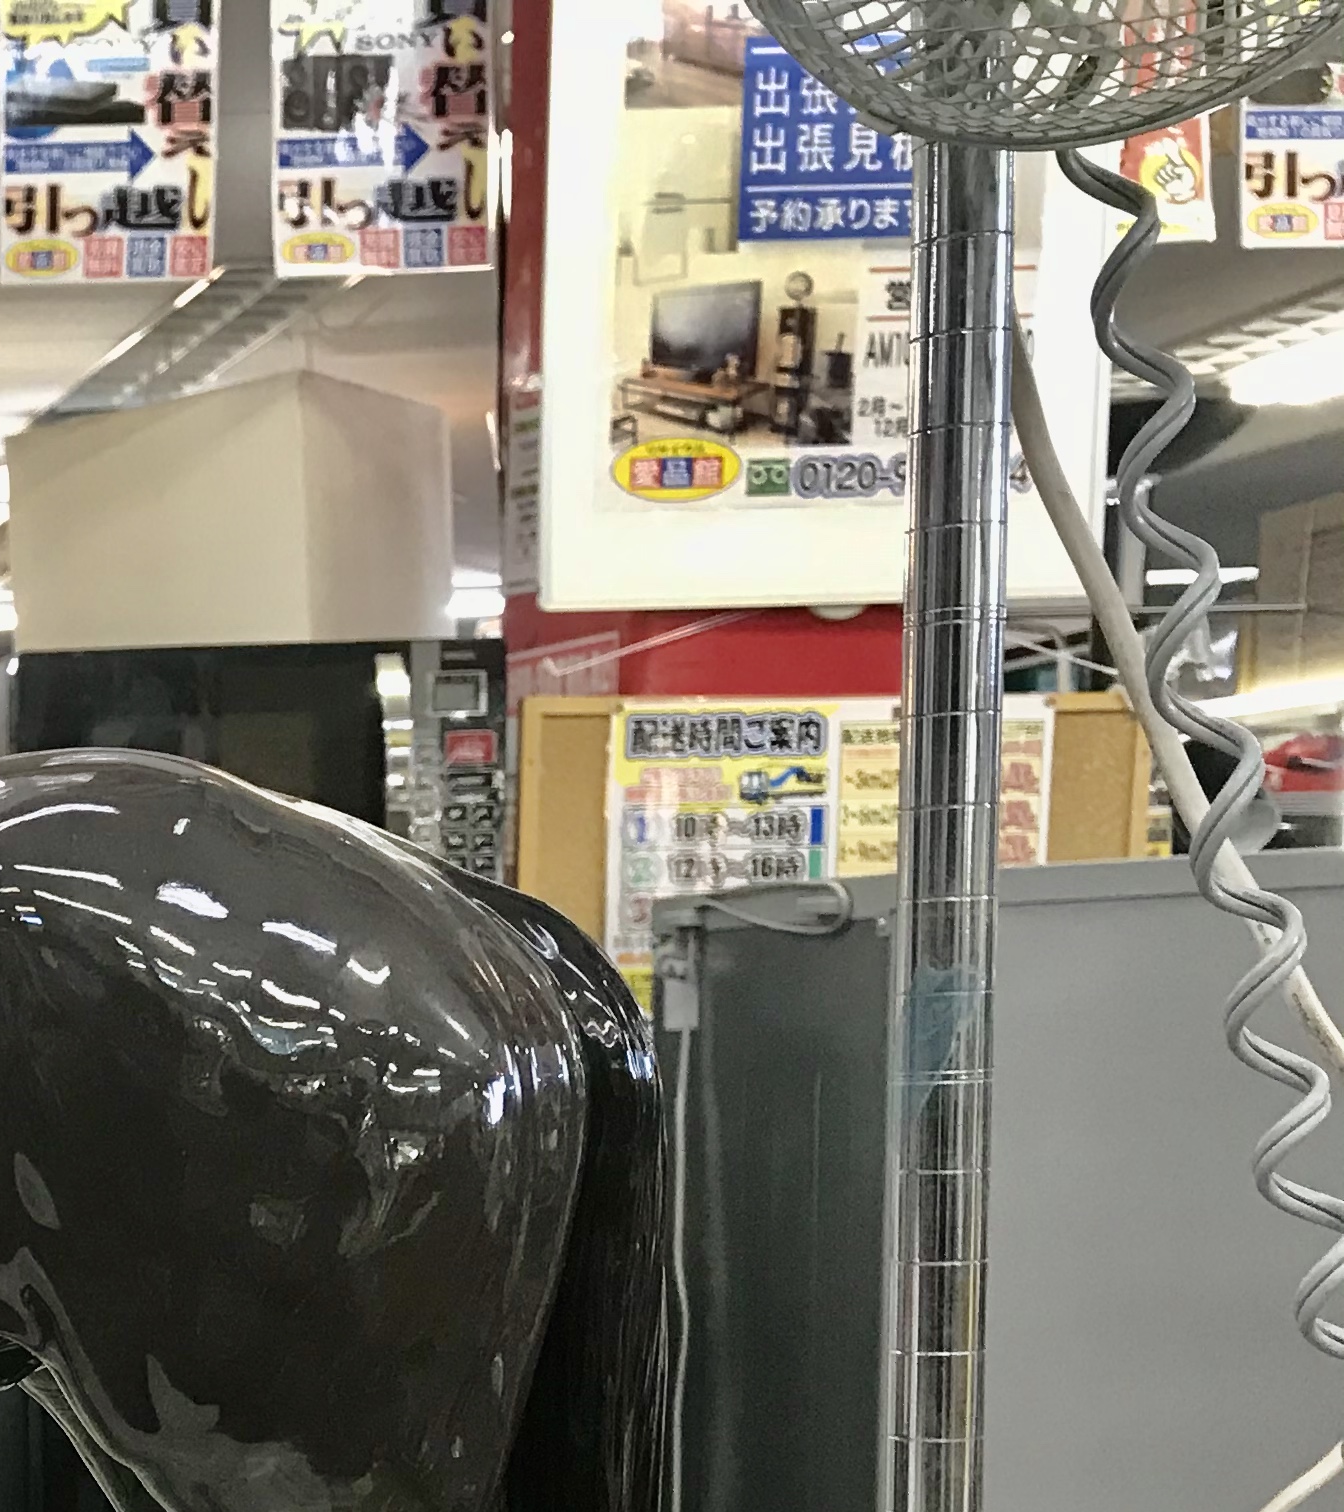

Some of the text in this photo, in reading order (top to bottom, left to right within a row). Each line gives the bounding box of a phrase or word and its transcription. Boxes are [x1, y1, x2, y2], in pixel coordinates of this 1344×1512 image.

[356, 31, 436, 50] SONY
[278, 159, 486, 230] 引っ越し
[1245, 151, 1344, 203] 引っ
[3, 165, 212, 237] 引っ越し
[750, 197, 911, 233] 予約承りま
[630, 716, 824, 757] 配送時間ご案内
